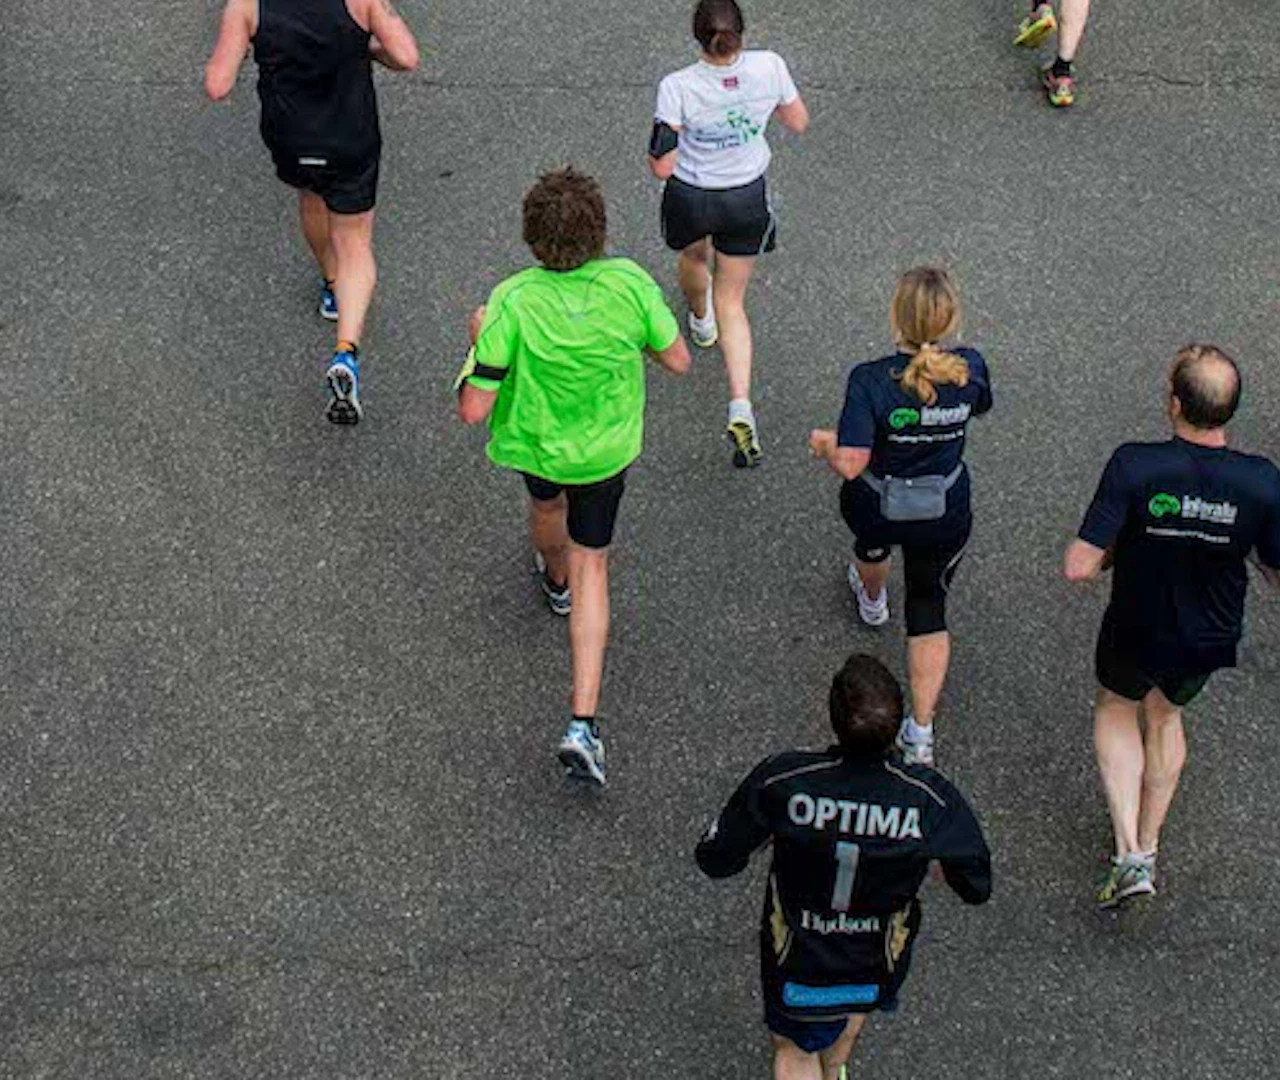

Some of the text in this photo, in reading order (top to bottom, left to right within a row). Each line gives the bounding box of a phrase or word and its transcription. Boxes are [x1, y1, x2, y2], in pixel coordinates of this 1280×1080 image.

[788, 793, 922, 839] OPTIMA
[831, 841, 859, 912] 1
[801, 909, 880, 935] Hudson
